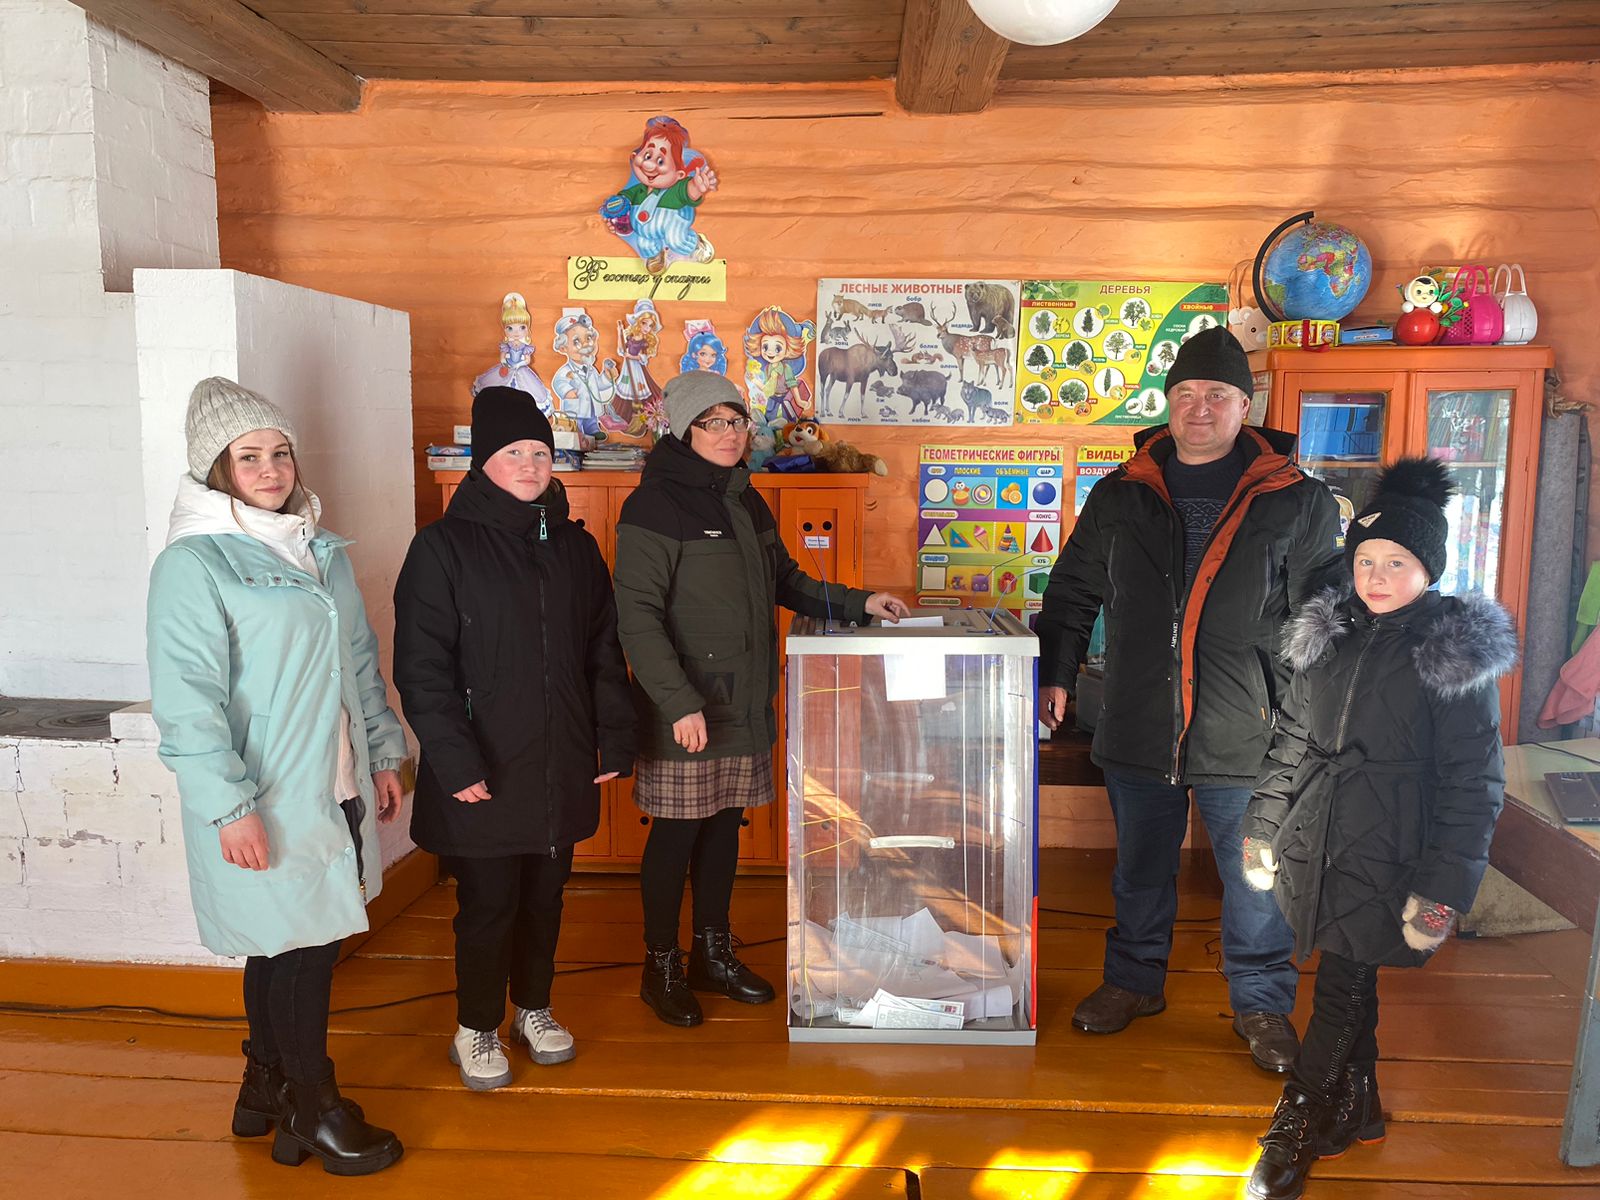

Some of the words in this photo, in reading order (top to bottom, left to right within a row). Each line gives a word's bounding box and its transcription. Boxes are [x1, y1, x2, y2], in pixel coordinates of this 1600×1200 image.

[840, 283, 889, 294] ЛЕСНЫЕ
[891, 283, 963, 294] ЖИВОТНЫЕ
[1100, 284, 1151, 295] ДЕРЕВЬЯ
[1182, 303, 1215, 311] хвойные
[923, 449, 1015, 461] ГЕОМЕТРИЧЕСКИЕ
[1017, 449, 1060, 461] ФИГУРЫ
[1086, 450, 1124, 461] ВИДЫ
[954, 467, 982, 475] ПЛОСКИЕ
[1170, 622, 1178, 649] CENTURY
